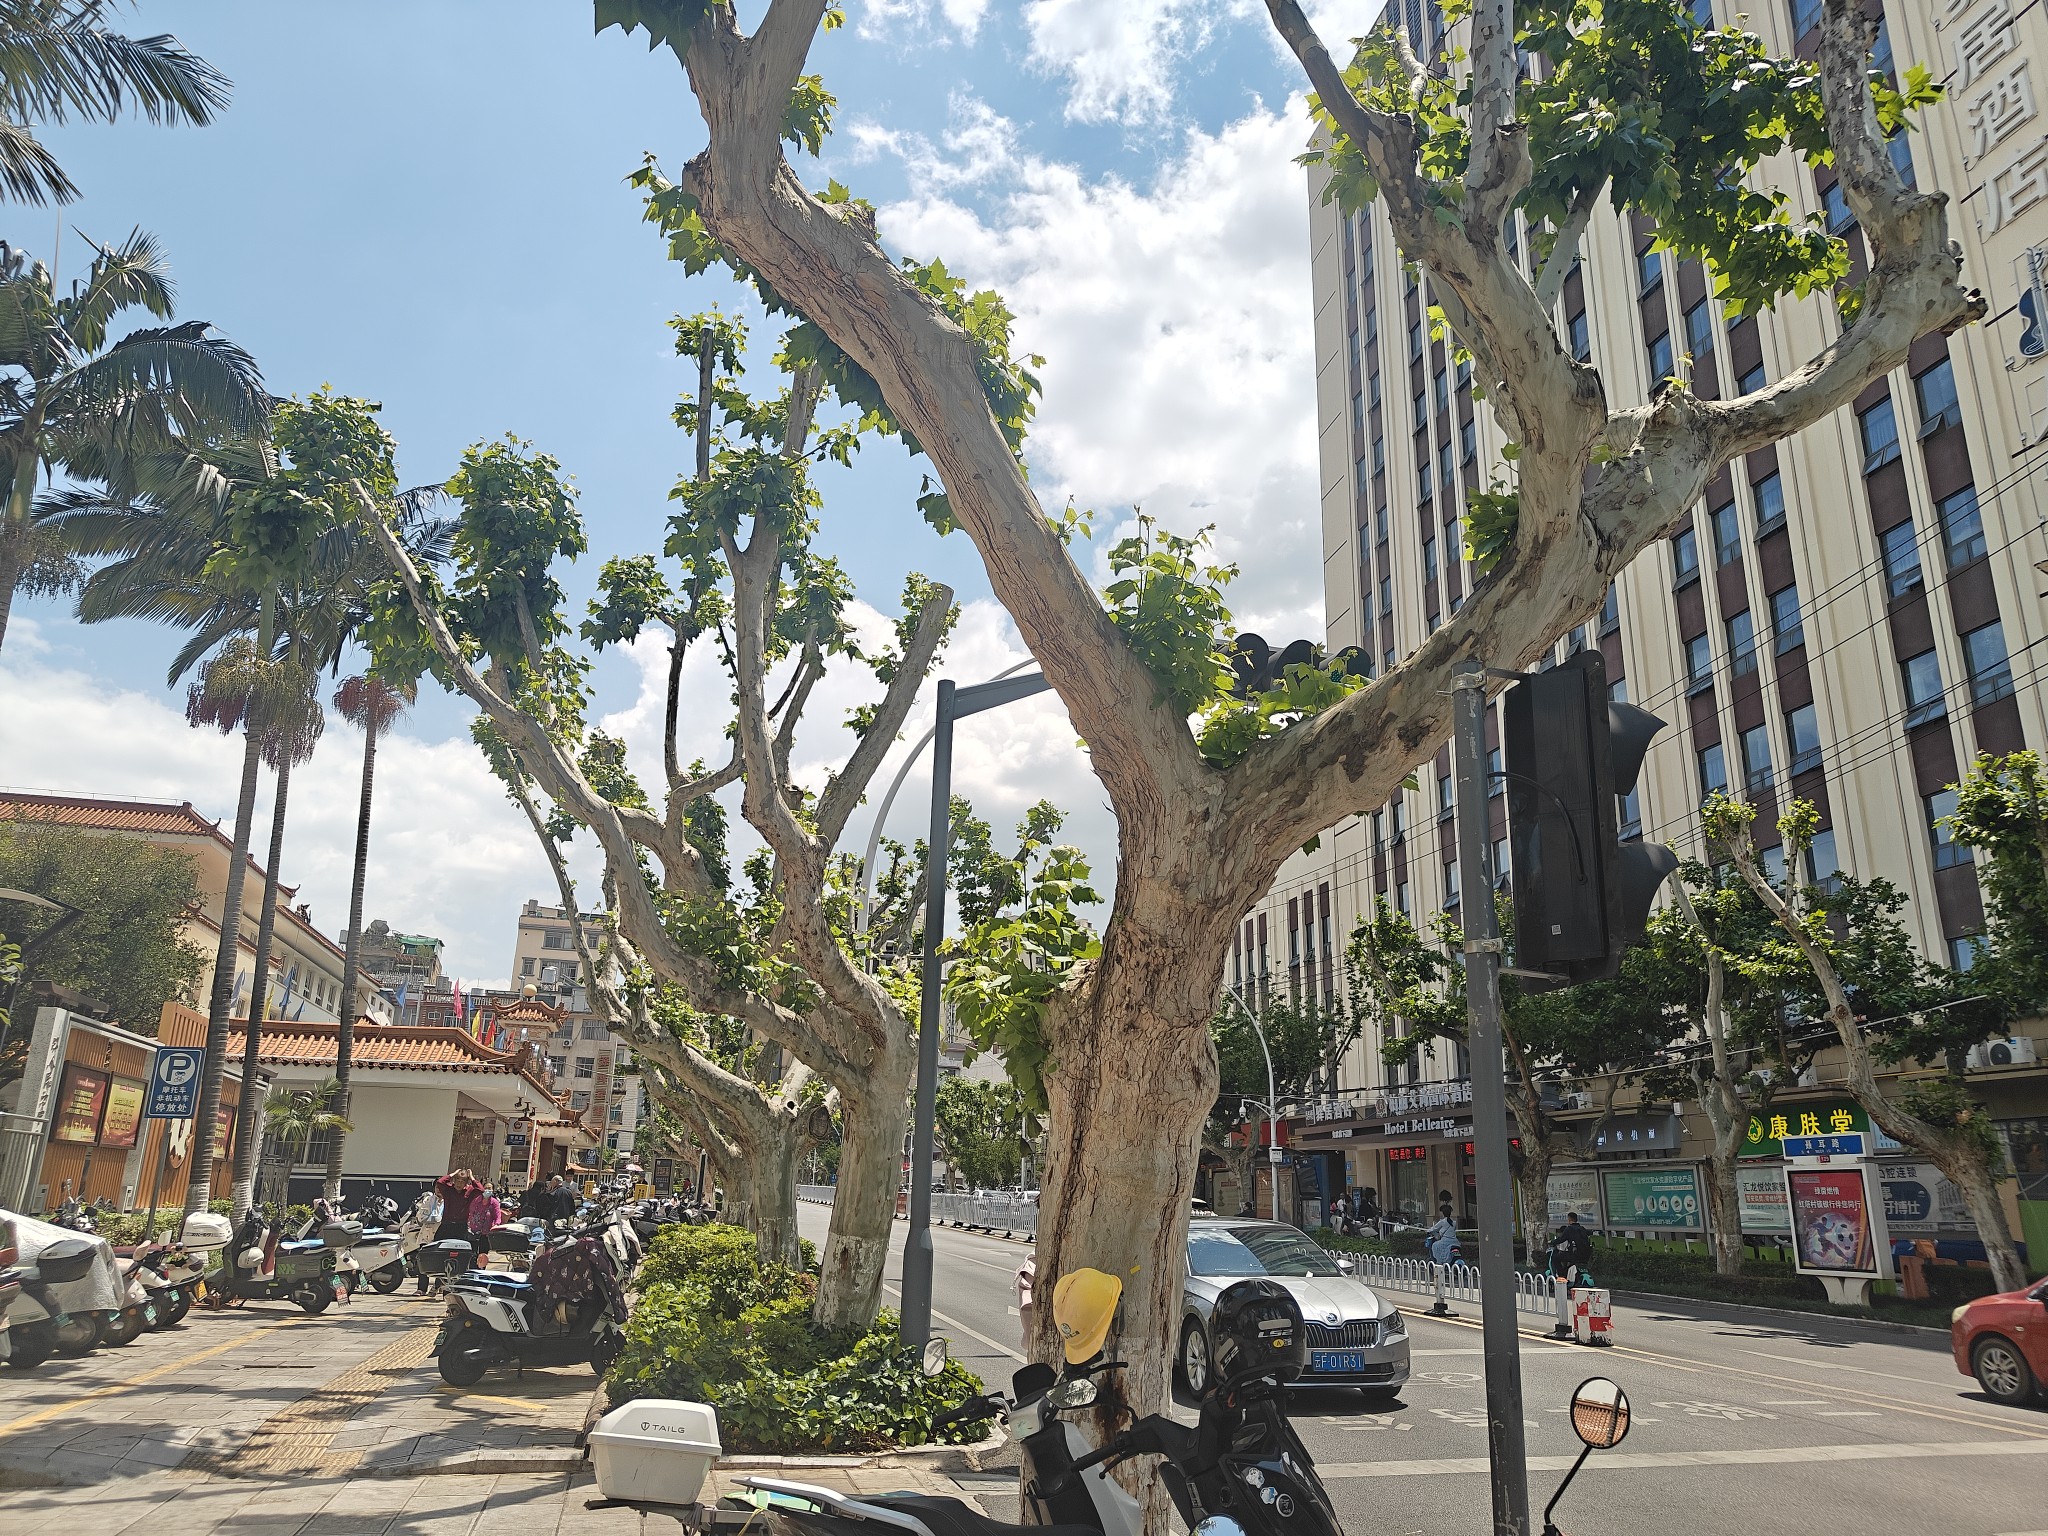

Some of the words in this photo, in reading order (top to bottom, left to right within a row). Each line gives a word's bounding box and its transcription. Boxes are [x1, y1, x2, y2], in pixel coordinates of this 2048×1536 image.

[1945, 0, 2048, 237] 居酒店
[161, 1085, 187, 1094] 摩托车
[156, 1094, 190, 1102] 非机动车
[155, 1102, 187, 1113] 停放处
[1384, 1119, 1409, 1136] Hotel
[1411, 1116, 1455, 1132] Belleaire
[1768, 1108, 1856, 1141] 康肤堂
[1257, 1328, 1294, 1339] LS2
[651, 1423, 685, 1434] TAILG
